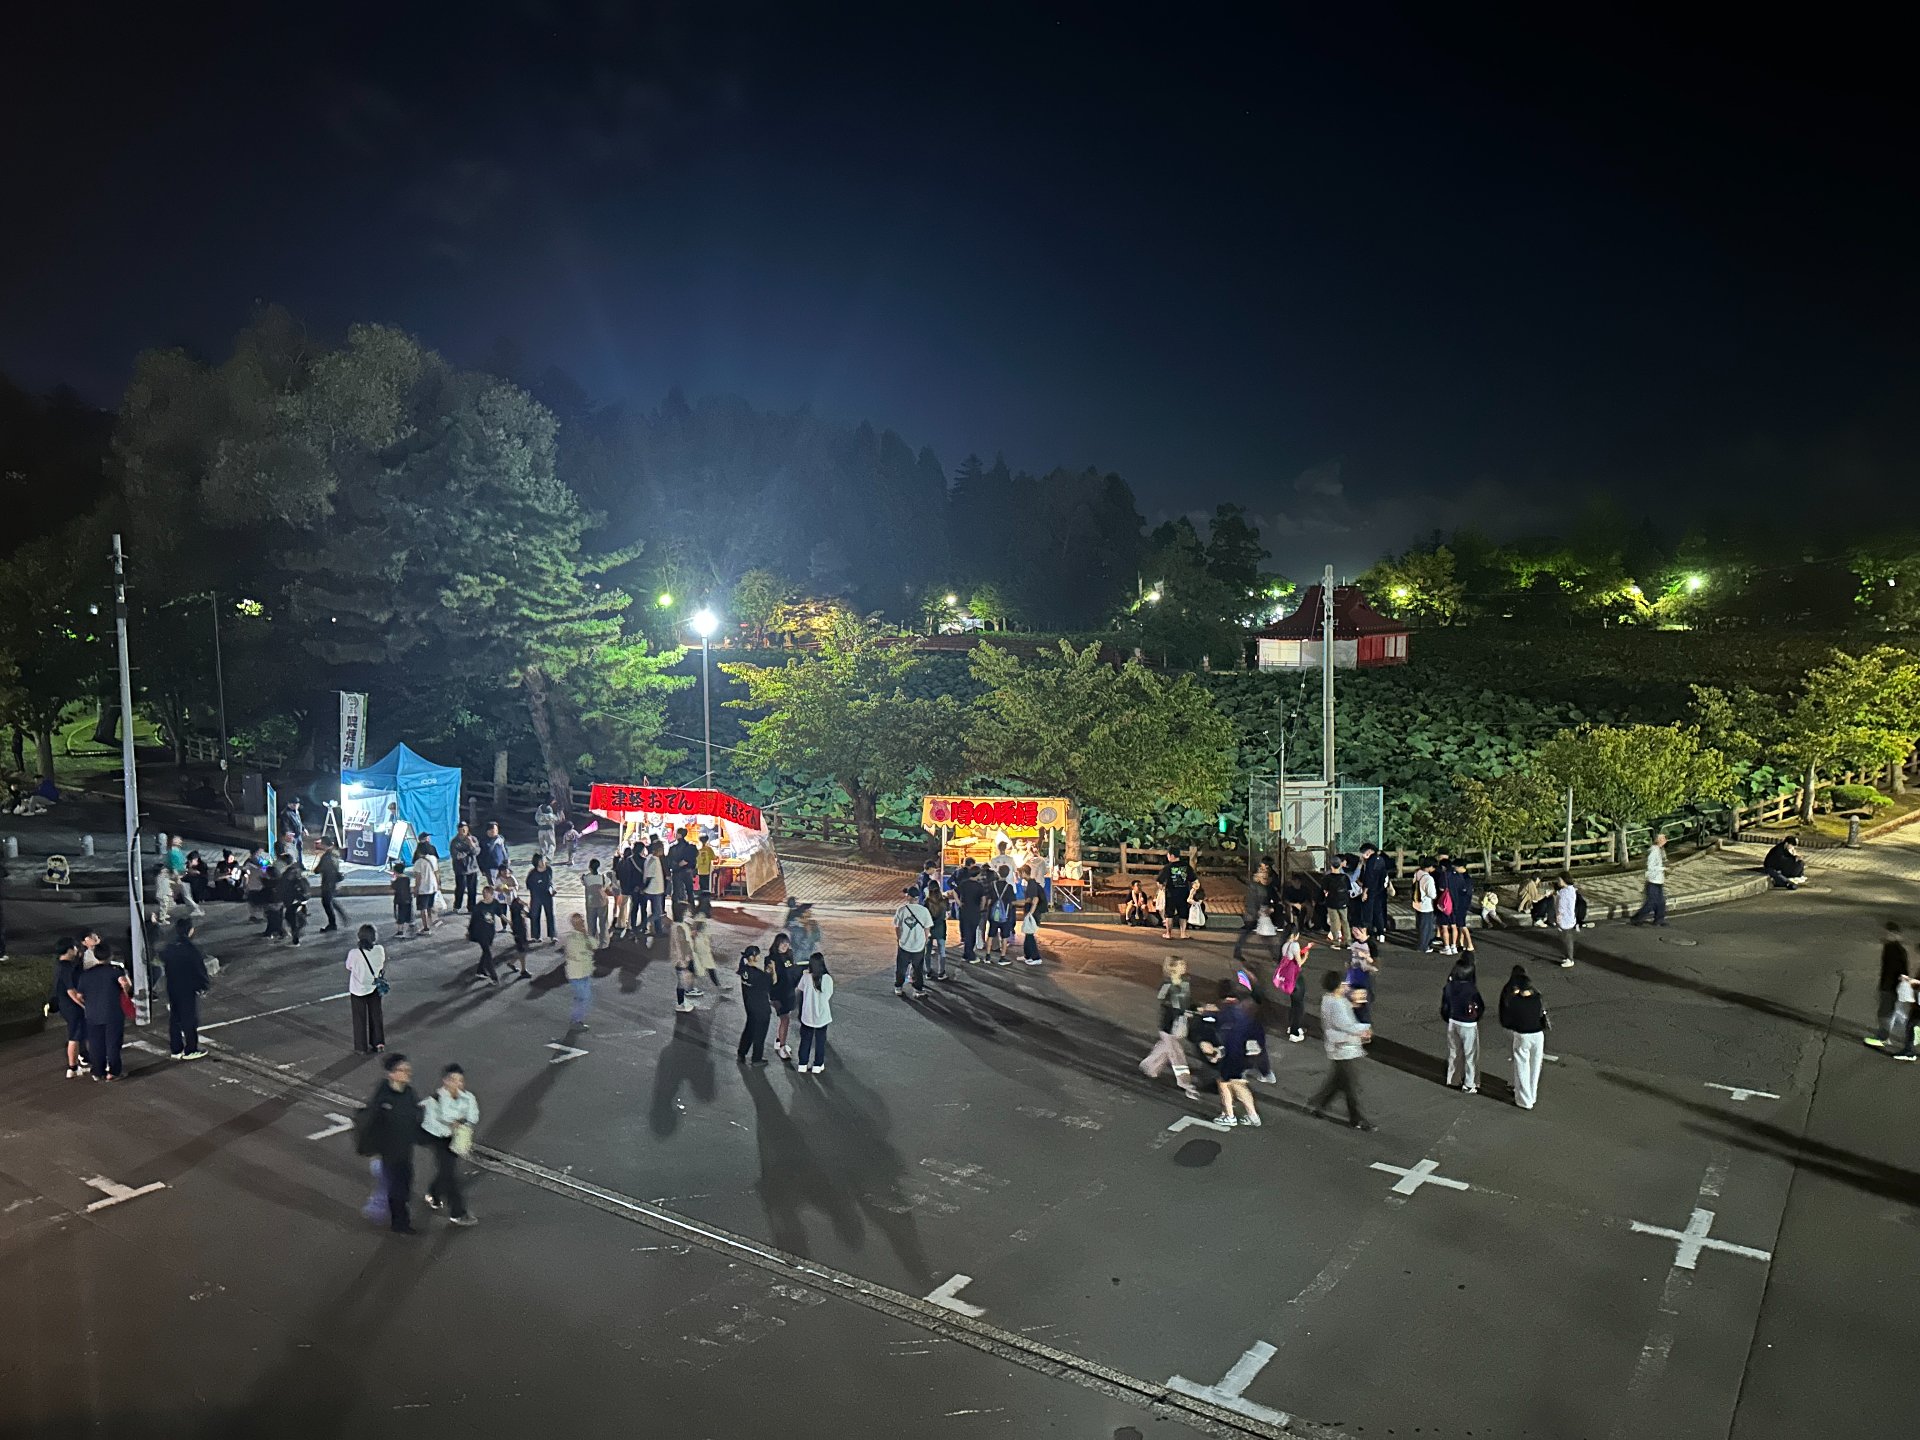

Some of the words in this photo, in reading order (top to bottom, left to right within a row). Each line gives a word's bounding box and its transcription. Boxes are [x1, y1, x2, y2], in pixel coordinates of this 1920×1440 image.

[611, 789, 694, 810] 津軽おでん
[352, 849, 369, 857] IQOS
